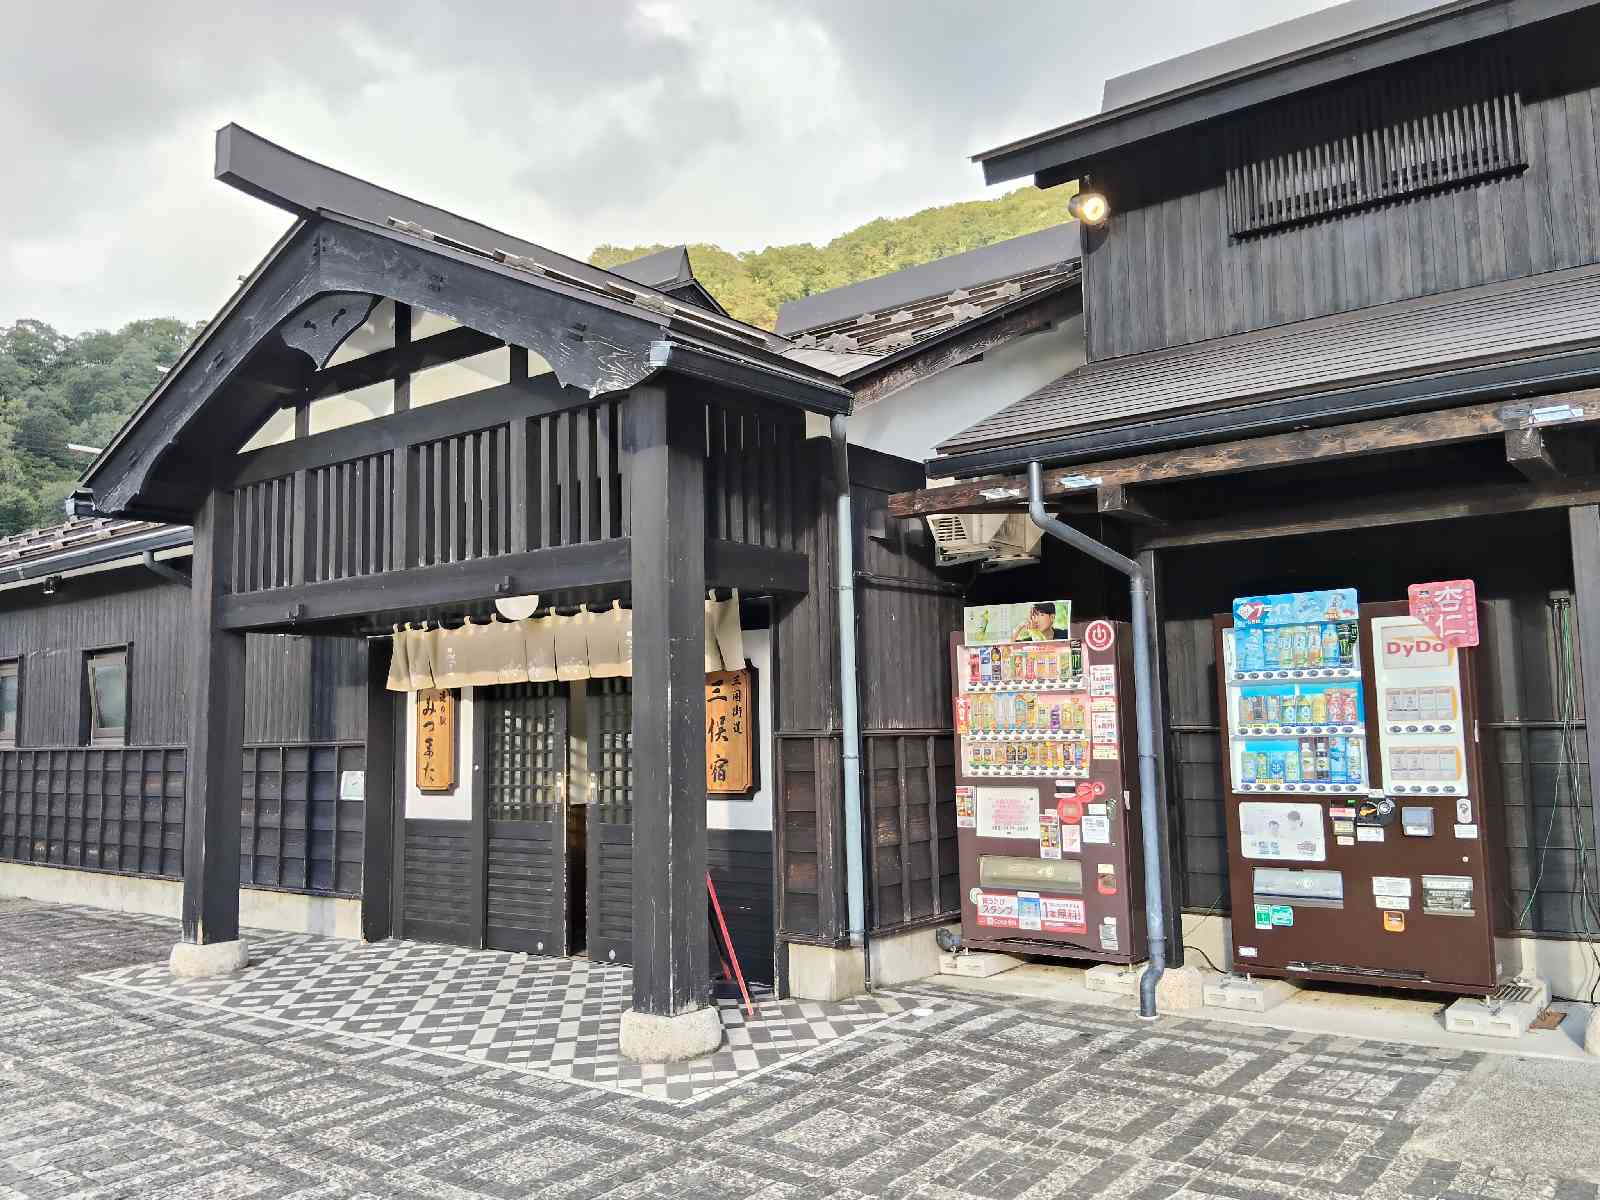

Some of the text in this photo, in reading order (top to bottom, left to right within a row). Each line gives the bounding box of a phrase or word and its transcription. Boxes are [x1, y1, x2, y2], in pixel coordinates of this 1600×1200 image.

[1433, 586, 1467, 639] 杏仁
[1386, 640, 1445, 657] DyDo
[422, 696, 436, 782] みつまた
